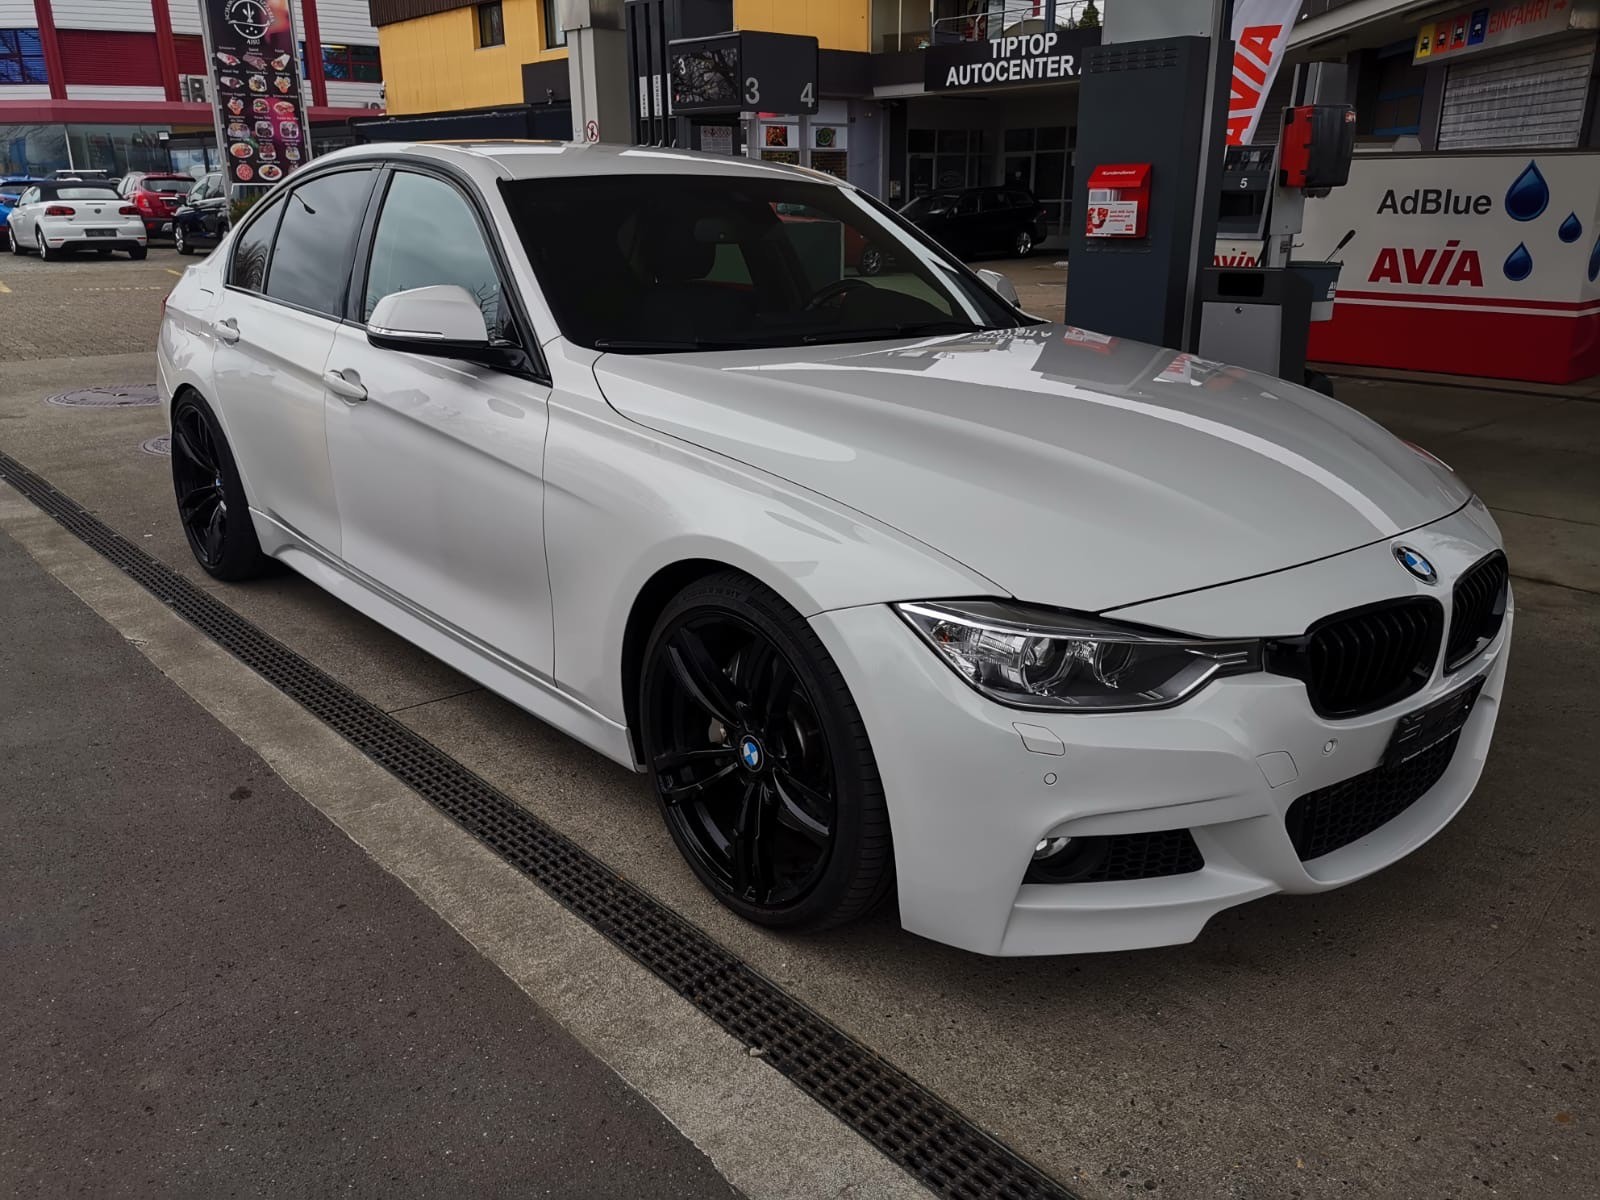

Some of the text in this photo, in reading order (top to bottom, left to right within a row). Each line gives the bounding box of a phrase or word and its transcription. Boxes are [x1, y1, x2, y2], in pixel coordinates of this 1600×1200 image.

[1488, 0, 1551, 33] EINFAHRT
[989, 32, 1058, 59] TIPTOP
[678, 58, 686, 74] 3
[945, 55, 1074, 87] AUTOCENTER
[745, 77, 760, 104] 3
[800, 82, 815, 108] 4
[1239, 178, 1248, 188] 5
[1376, 189, 1492, 215] AdBlue
